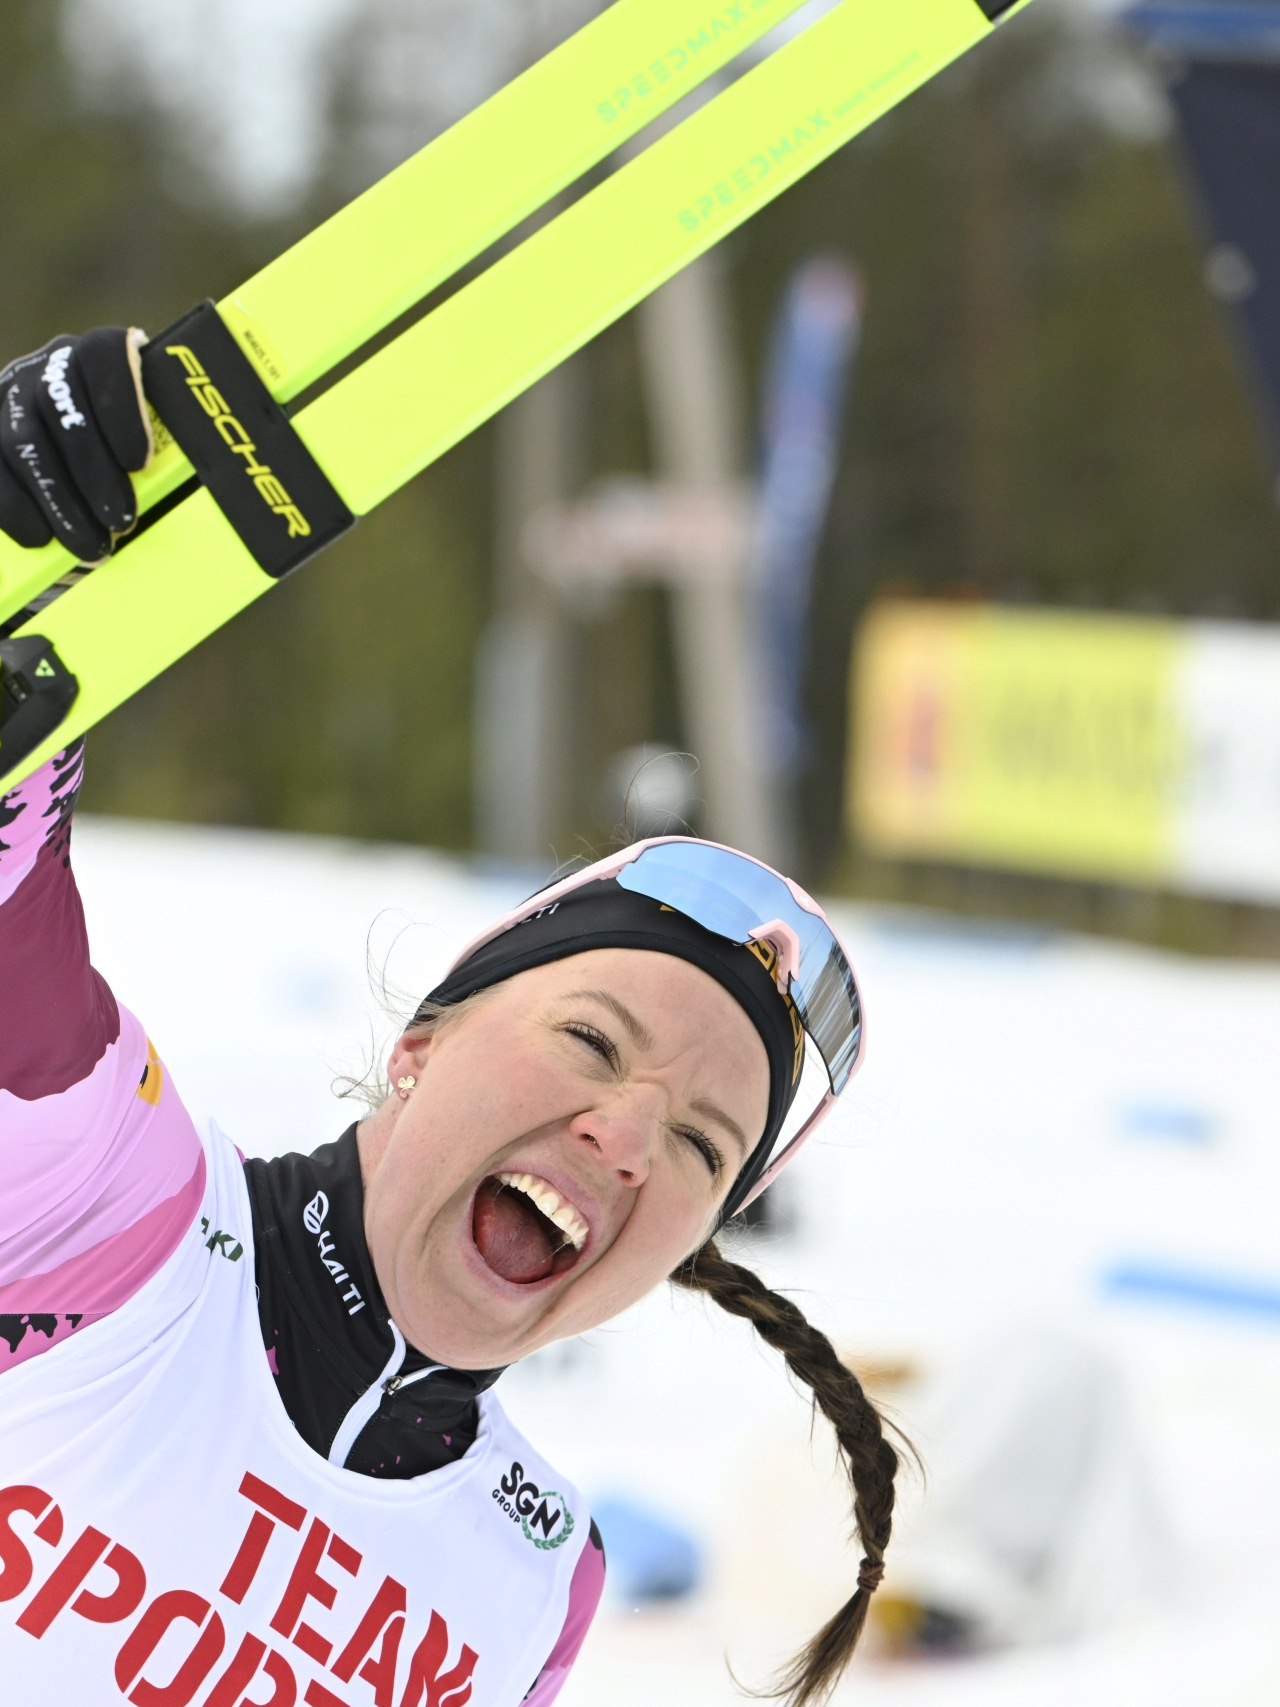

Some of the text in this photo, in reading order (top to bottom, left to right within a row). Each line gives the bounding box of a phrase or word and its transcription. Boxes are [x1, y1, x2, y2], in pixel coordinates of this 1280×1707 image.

[596, 1, 749, 124] SPEEDMAX
[677, 109, 830, 233] SPEEDMAX
[165, 345, 311, 539] FISCHER
[492, 1489, 520, 1523] GROUP
[501, 1461, 561, 1539] SGN
[219, 1471, 480, 1707] TEAM
